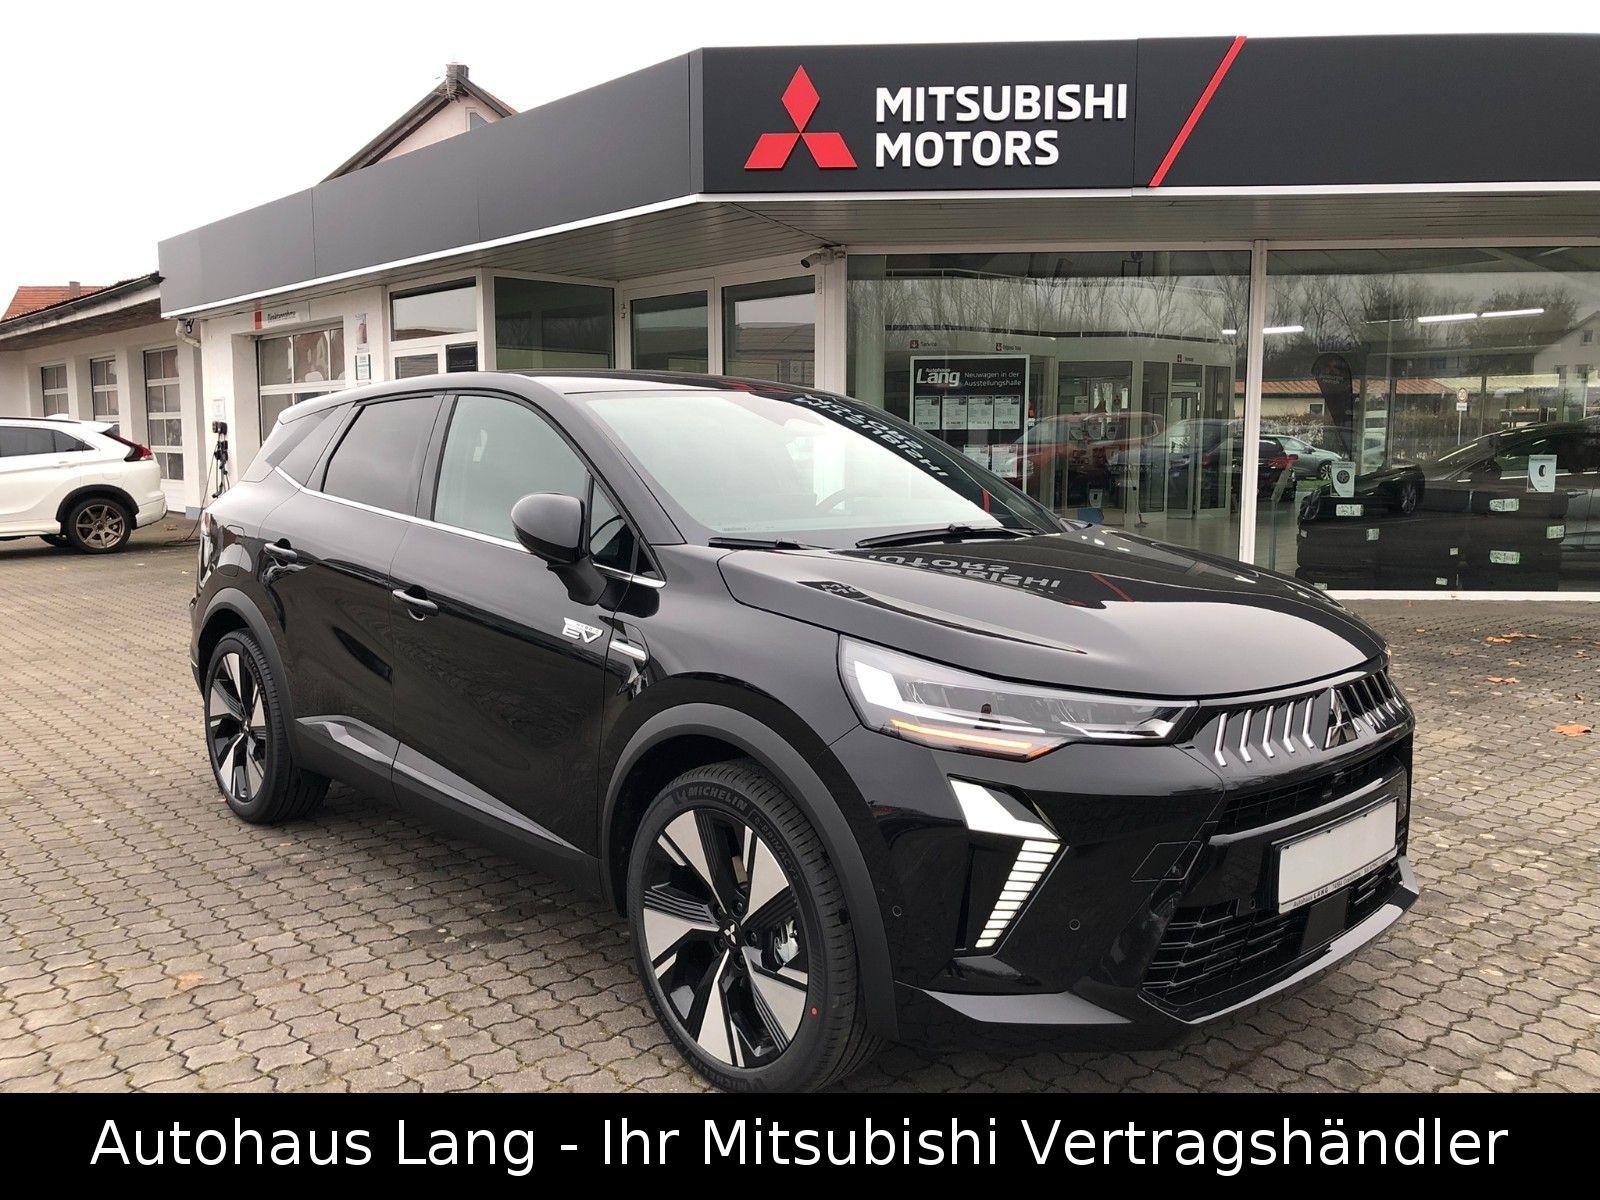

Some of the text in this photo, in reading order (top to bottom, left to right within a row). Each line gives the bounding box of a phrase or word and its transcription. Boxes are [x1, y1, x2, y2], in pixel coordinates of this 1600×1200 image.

[875, 83, 1128, 123] MITSUBISHI
[875, 129, 1059, 168] MOTORS
[916, 368, 960, 387] Lang
[964, 372, 999, 380] Neuwagen
[689, 785, 748, 811] MICHELIN
[1313, 887, 1329, 899] LANG
